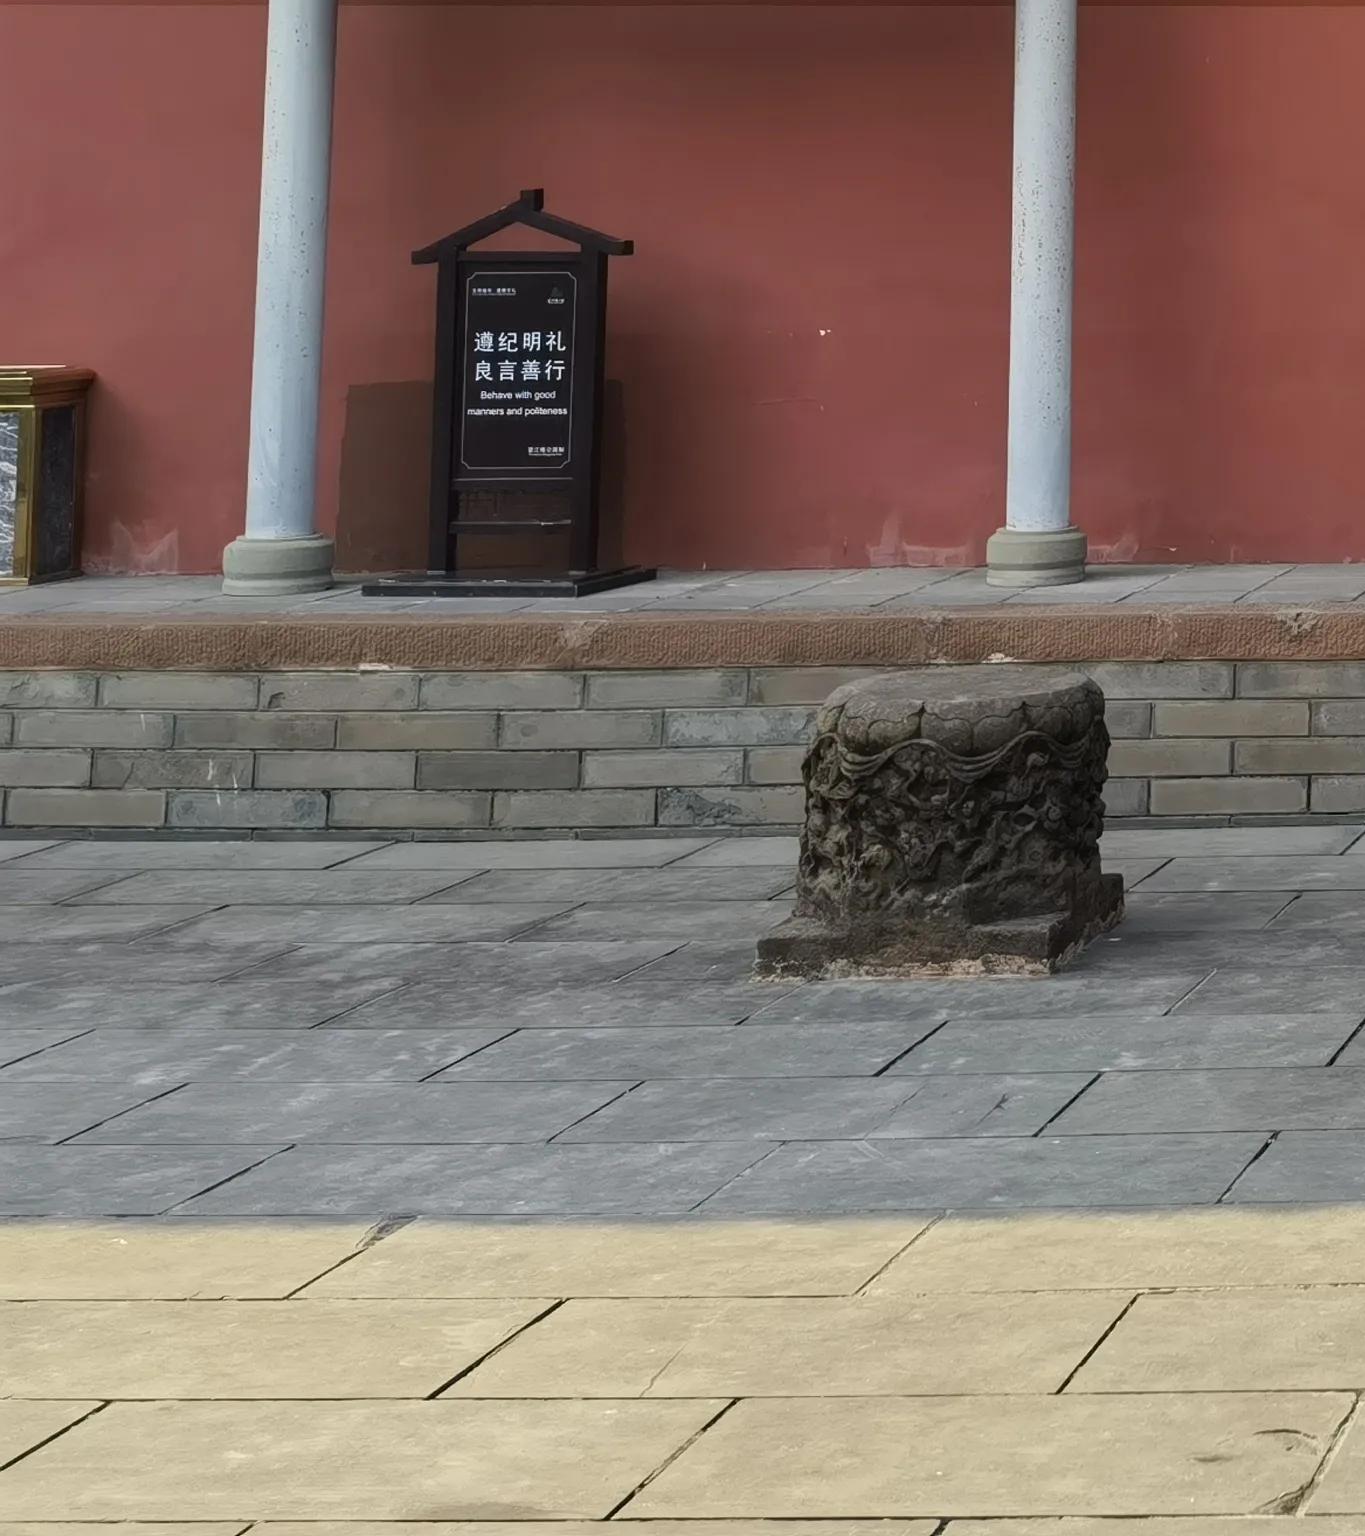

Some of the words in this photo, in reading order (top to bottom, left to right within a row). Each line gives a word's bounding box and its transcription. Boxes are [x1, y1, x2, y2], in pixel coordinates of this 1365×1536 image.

[473, 330, 567, 352] 遵纪明礼
[475, 359, 566, 381] 良言善行
[480, 390, 513, 400] Behave
[514, 390, 533, 400] with
[534, 390, 556, 401] good
[467, 408, 504, 416] manners
[506, 407, 522, 416] and
[524, 407, 568, 417] politeness
